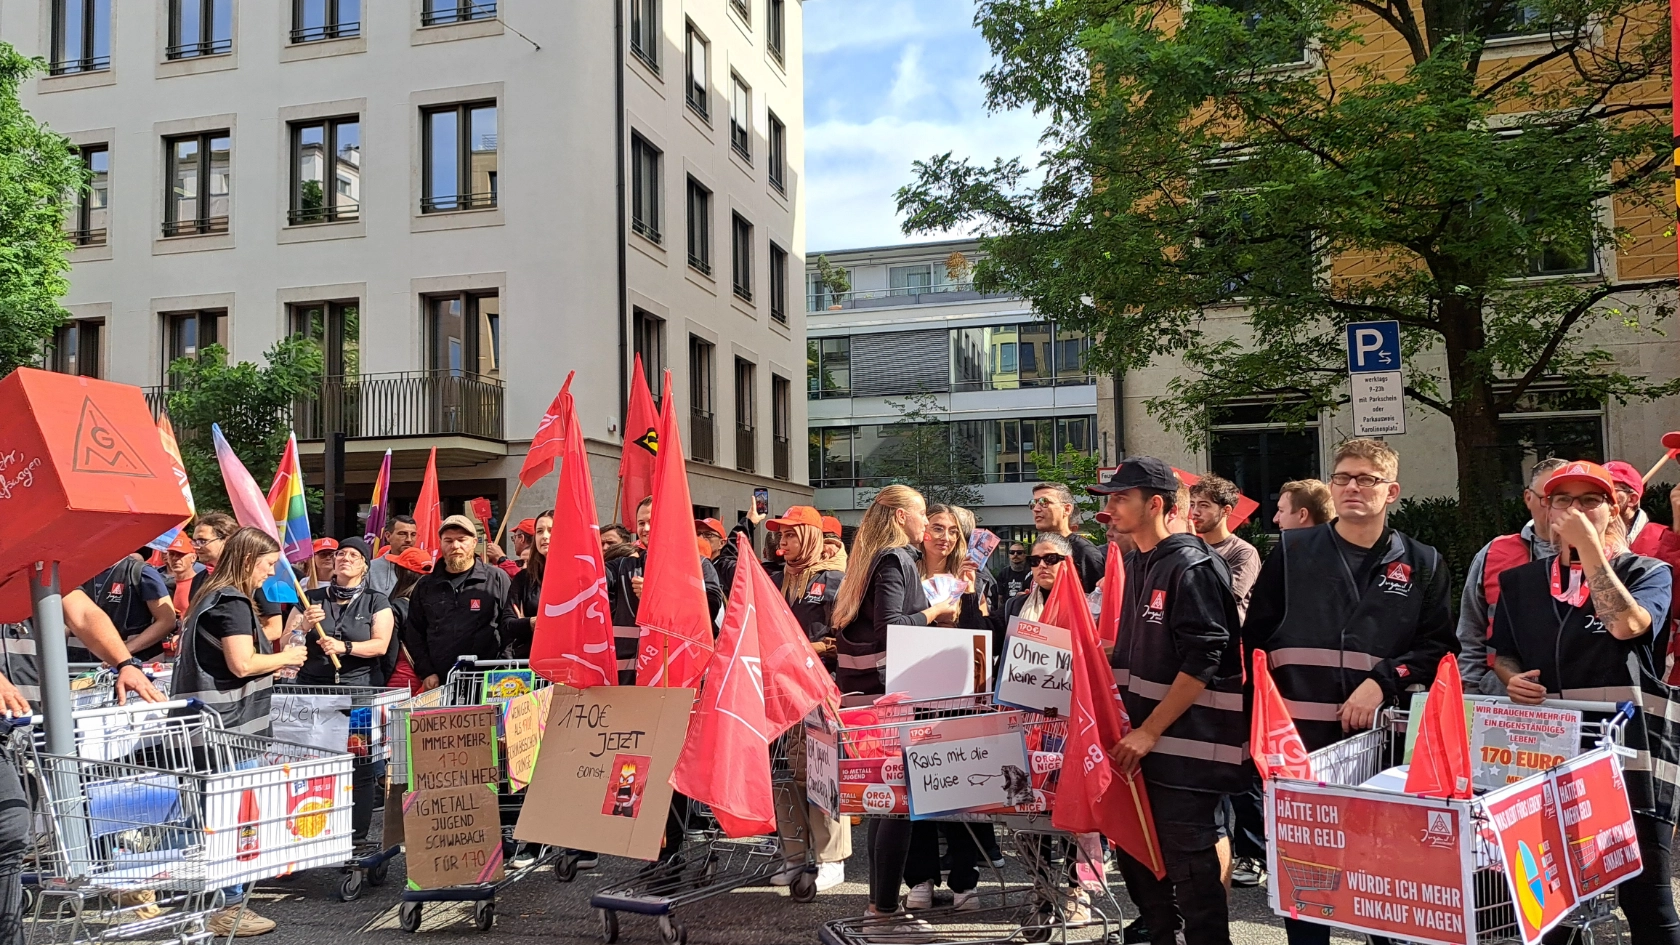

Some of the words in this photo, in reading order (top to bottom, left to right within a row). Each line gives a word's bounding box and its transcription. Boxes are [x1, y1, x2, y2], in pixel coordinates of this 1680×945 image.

[1356, 328, 1384, 367] P
[1369, 394, 1397, 402] Parkschein
[1019, 623, 1040, 634] 170€
[1013, 642, 1050, 666] Ohne
[1056, 651, 1073, 672] NA
[1008, 663, 1037, 685] Keine
[511, 701, 531, 720] WENIGER
[558, 704, 612, 729] 170€
[1493, 708, 1535, 718] BRAUCHEN
[1536, 711, 1559, 720] MEHR
[1560, 713, 1577, 722] FÜR
[410, 715, 447, 734] DÖNER
[449, 712, 494, 729] KOSTET
[910, 729, 932, 737] 170€
[1484, 719, 1497, 727] EIN
[1498, 720, 1565, 734] EIGENSTÄNDIGES
[422, 735, 455, 751] IMMER
[457, 733, 490, 749] MEHR,
[589, 731, 645, 757] JETZT
[1509, 735, 1537, 744] LEBEN!
[438, 751, 469, 768] 170
[885, 764, 905, 772] ORG
[909, 751, 943, 770] Raus
[947, 747, 967, 763] mit
[970, 747, 989, 760] die
[1035, 754, 1062, 763] ORGA
[1480, 746, 1512, 766] 170
[1516, 751, 1567, 771] EURO
[417, 770, 468, 790] MÜSSEN
[471, 767, 498, 785] HER
[923, 773, 960, 792] Mäuse
[866, 791, 892, 800] ORGA
[1559, 781, 1578, 803] HÄTTE
[416, 799, 430, 816] IG
[431, 793, 480, 815] METALL
[1277, 797, 1314, 822] HÄTTE
[1316, 805, 1339, 824] ICH
[431, 814, 474, 831] JUGEND
[425, 829, 485, 850] SCHWABACH
[1277, 823, 1311, 845] MEHR
[1314, 829, 1346, 849] GELD
[434, 855, 459, 872] FÜR
[462, 849, 486, 868] 170
[1346, 869, 1392, 897] WÜRDE
[1395, 879, 1418, 901] ICH
[1421, 884, 1461, 908] MEHR
[1353, 897, 1409, 924] EINKAUF
[1413, 907, 1463, 934] WAGEN
